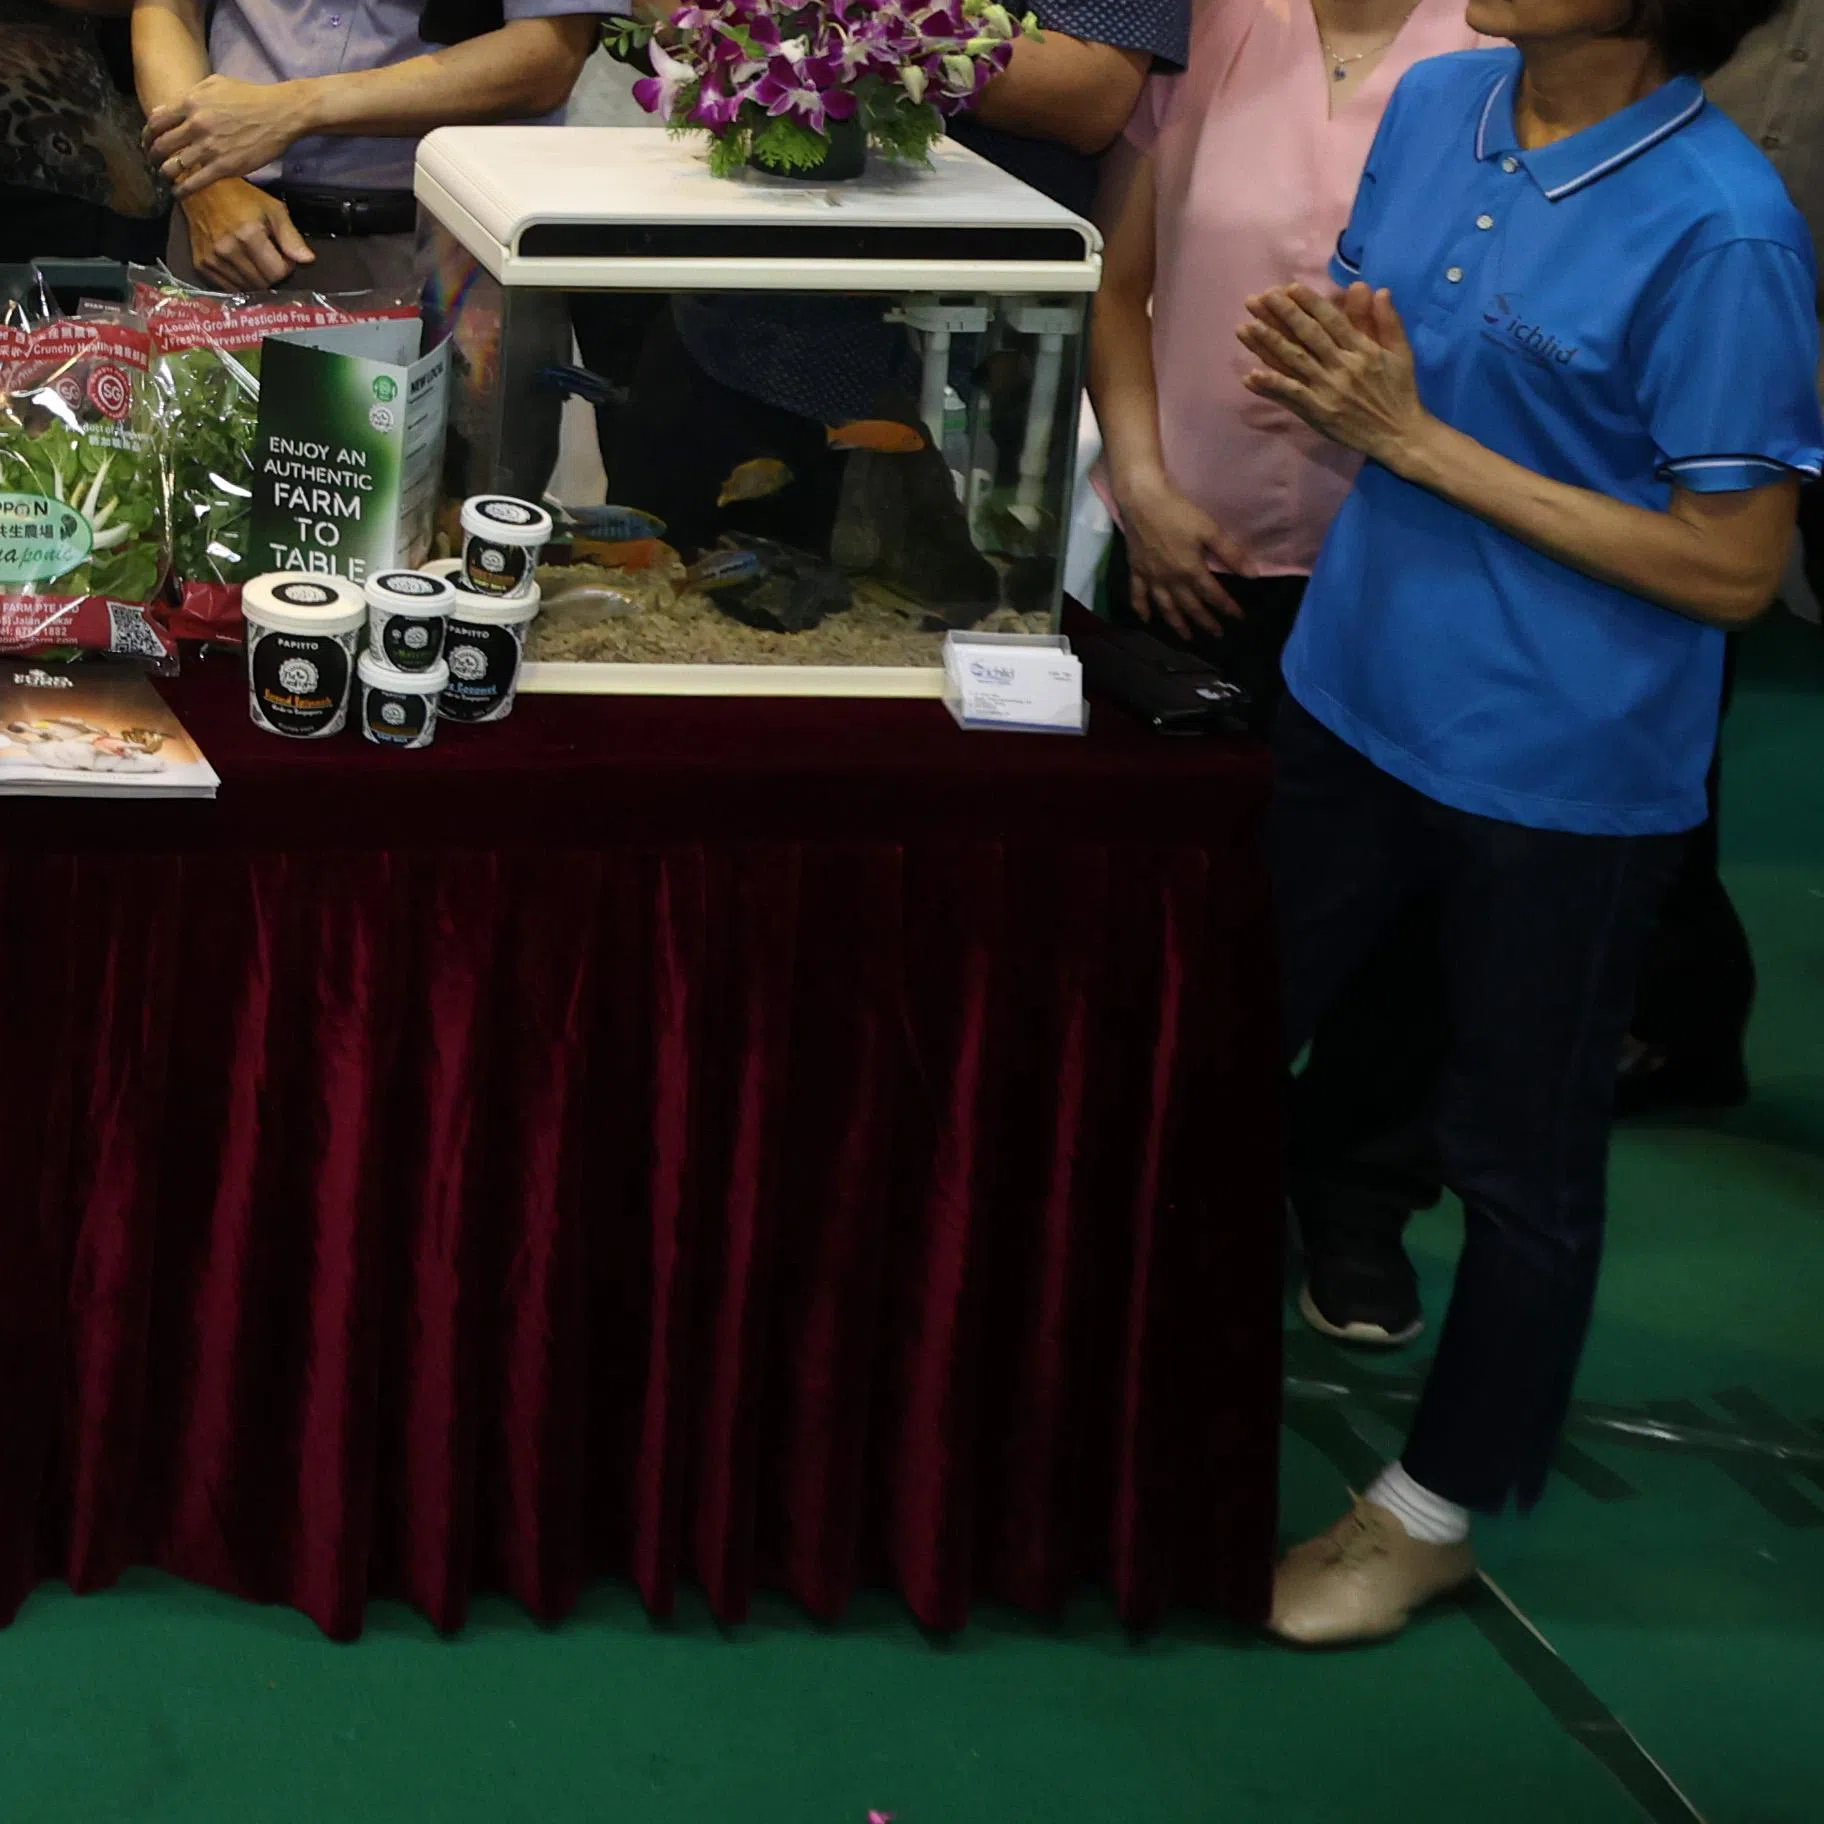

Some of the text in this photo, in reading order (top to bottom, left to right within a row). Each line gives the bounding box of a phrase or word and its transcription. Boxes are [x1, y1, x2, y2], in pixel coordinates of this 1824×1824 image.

[203, 316, 238, 332] Grown
[240, 311, 290, 328] Pesticide
[34, 343, 77, 357] Crunchy
[102, 382, 124, 401] SG
[269, 436, 366, 467] ENJOY AN
[264, 459, 373, 491] AUTHENTIC
[274, 482, 361, 520] FARM
[295, 517, 340, 547] TO
[270, 543, 366, 583] TABLE
[3, 600, 33, 613] FARM
[35, 601, 56, 613] PTE
[448, 625, 490, 639] PAPITTO
[277, 637, 319, 651] PAPITTO
